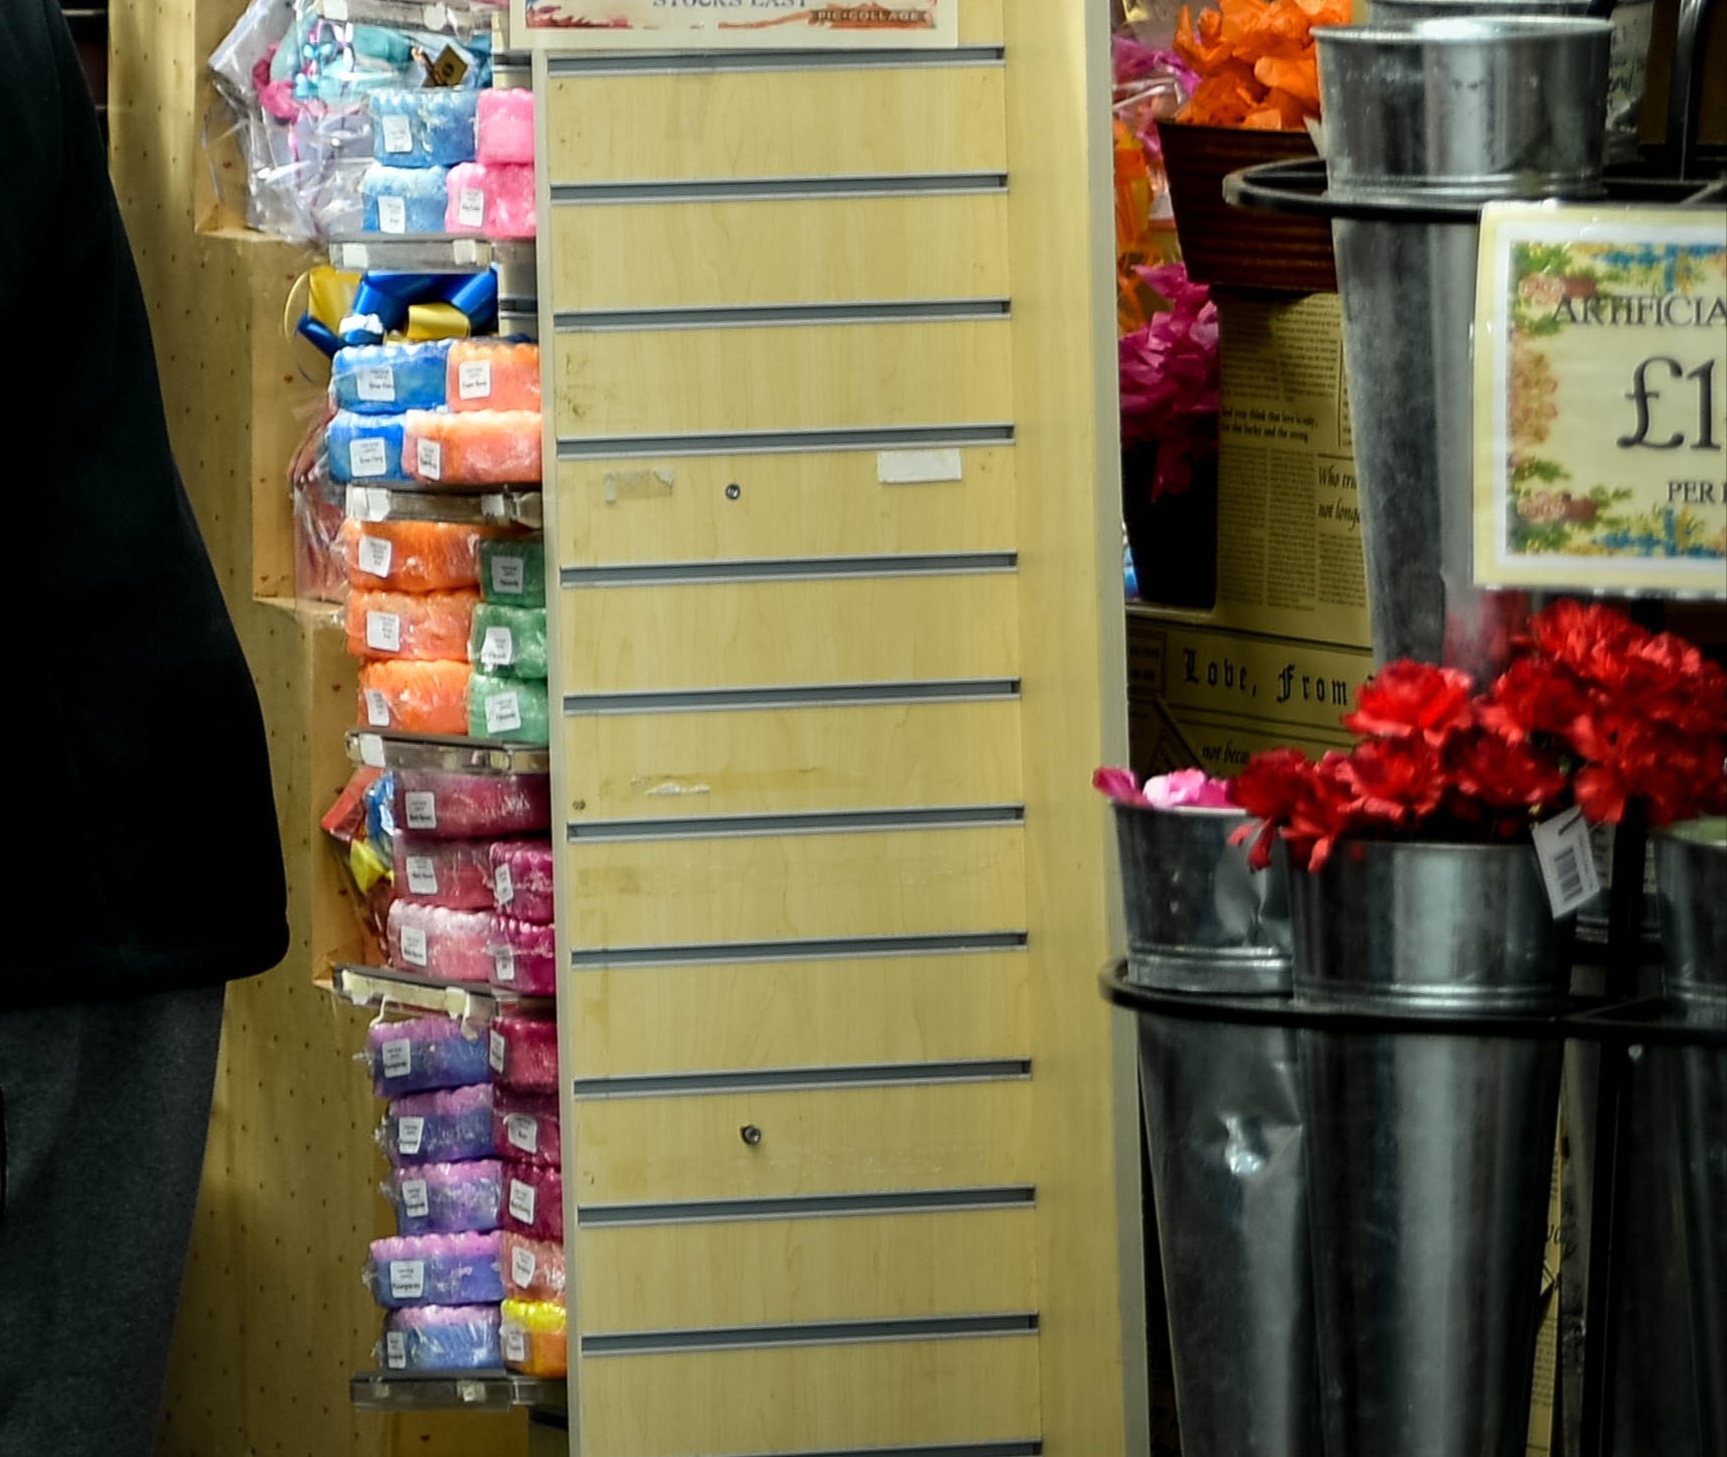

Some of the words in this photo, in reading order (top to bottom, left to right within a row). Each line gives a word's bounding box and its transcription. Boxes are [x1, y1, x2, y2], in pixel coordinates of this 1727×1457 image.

[1318, 465, 1340, 488] Who
[1668, 480, 1716, 505] PER
[1182, 648, 1257, 699] Love,
[1276, 663, 1348, 707] From
